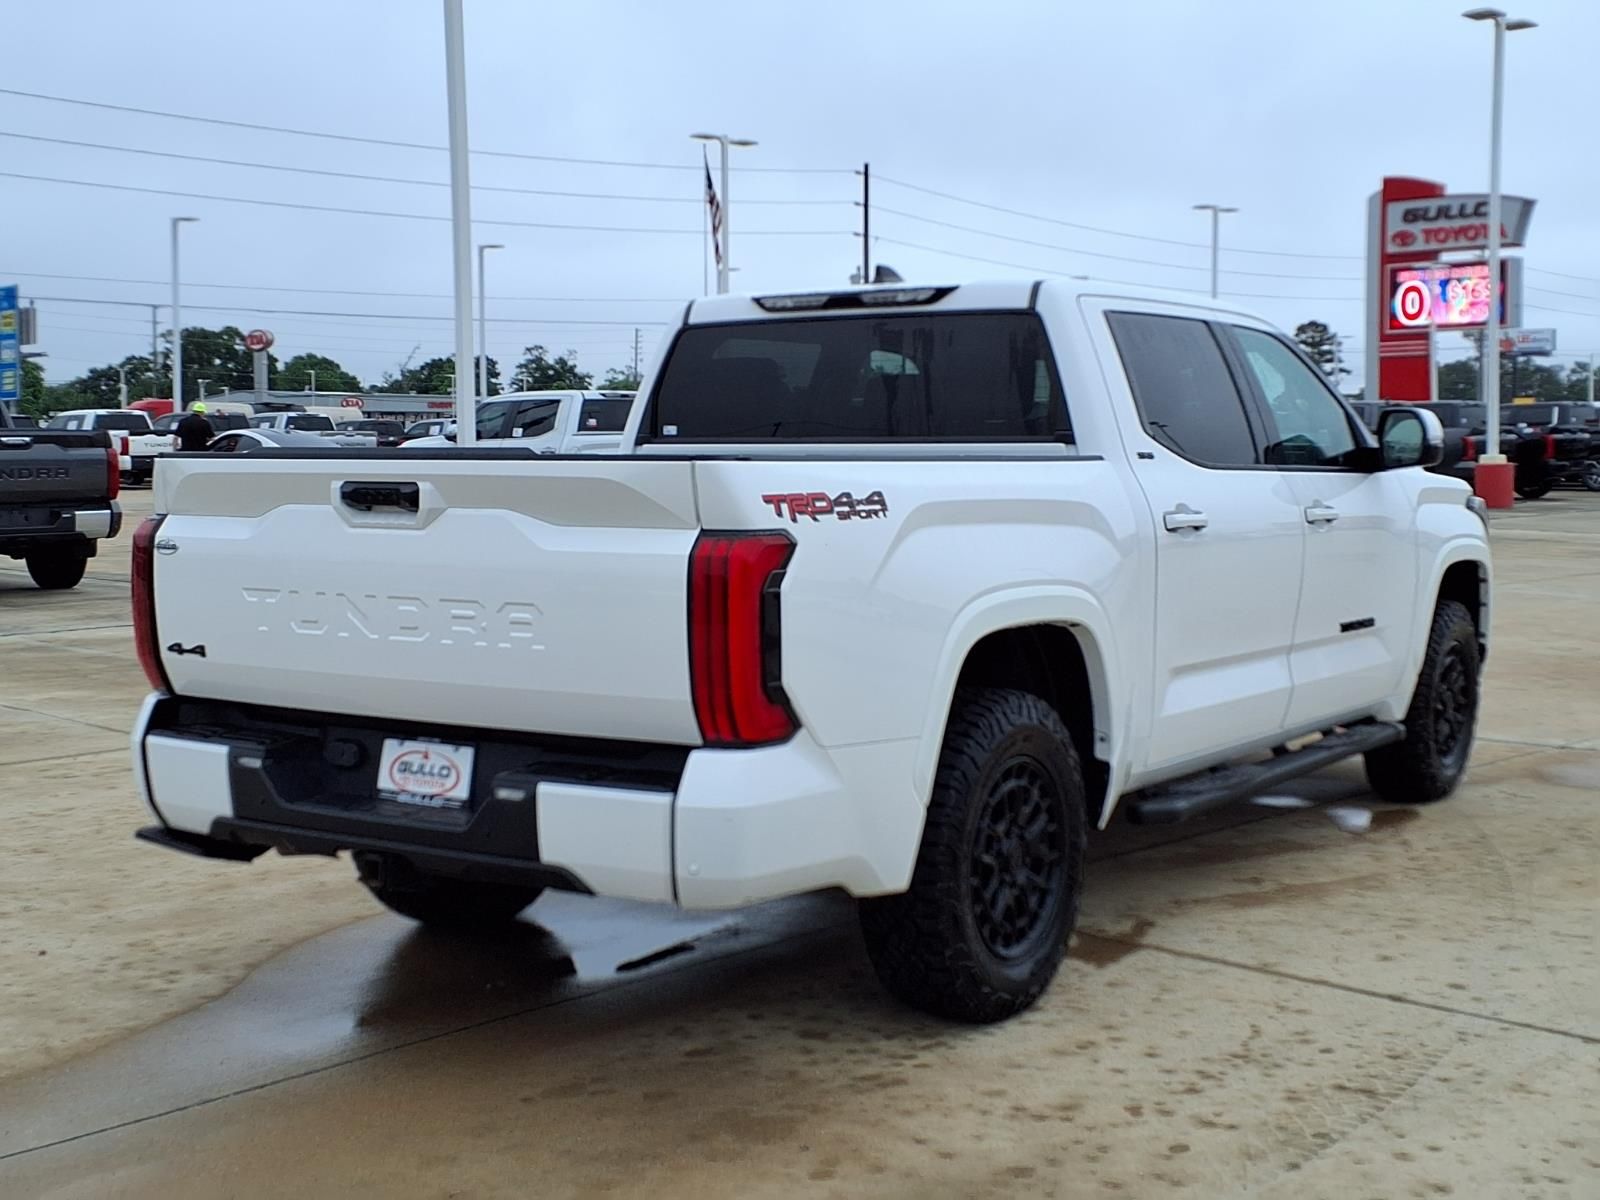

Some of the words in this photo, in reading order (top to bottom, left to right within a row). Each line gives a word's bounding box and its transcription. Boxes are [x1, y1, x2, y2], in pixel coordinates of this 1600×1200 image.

[761, 492, 834, 523] TRD
[836, 508, 888, 521] SPORT
[242, 587, 546, 650] TUNDRA
